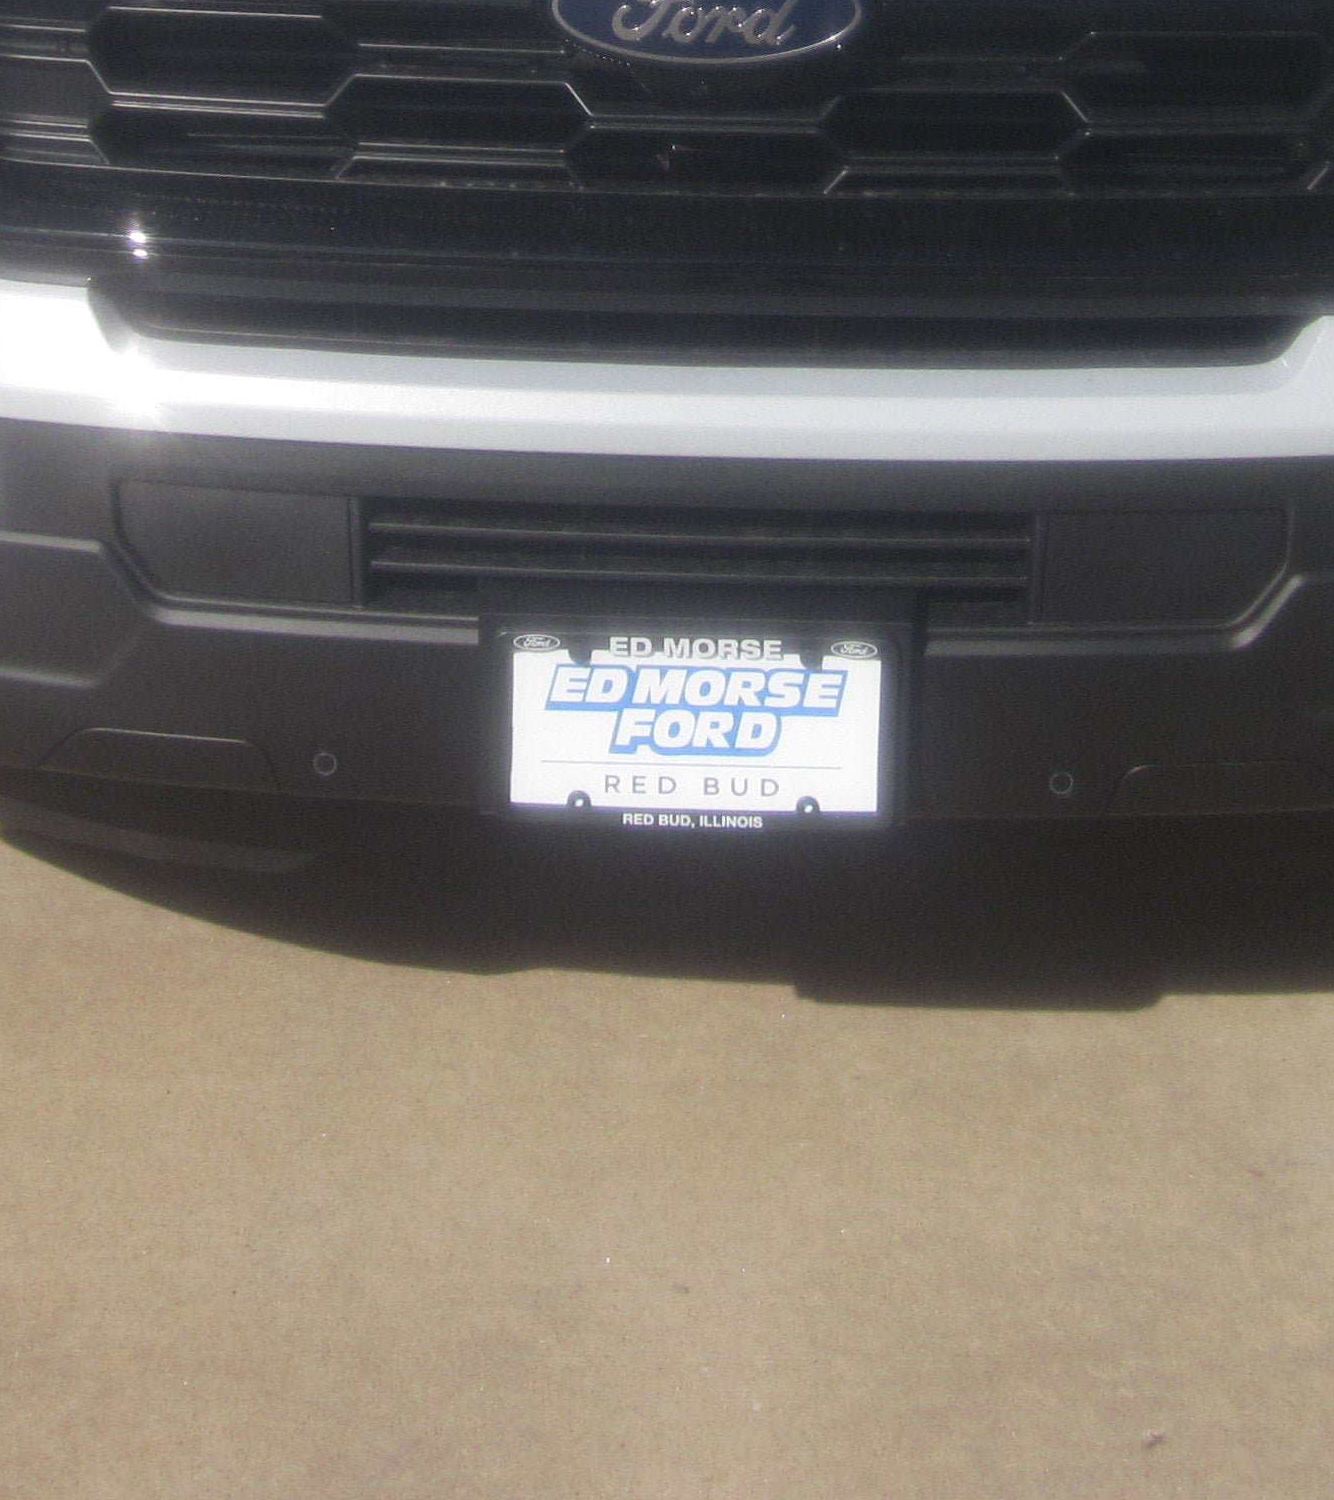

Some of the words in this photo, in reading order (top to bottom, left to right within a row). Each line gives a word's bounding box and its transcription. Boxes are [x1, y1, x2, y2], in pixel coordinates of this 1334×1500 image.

[609, 636, 653, 659] ED
[663, 637, 783, 661] MORSE
[547, 666, 629, 706] ED
[630, 666, 846, 711] MORSE
[612, 708, 780, 752] FORD
[604, 774, 677, 795] RED
[703, 776, 780, 797] BUD
[622, 813, 655, 826] RED
[658, 814, 695, 828] BUD,
[699, 815, 763, 829] ILLINOIS
